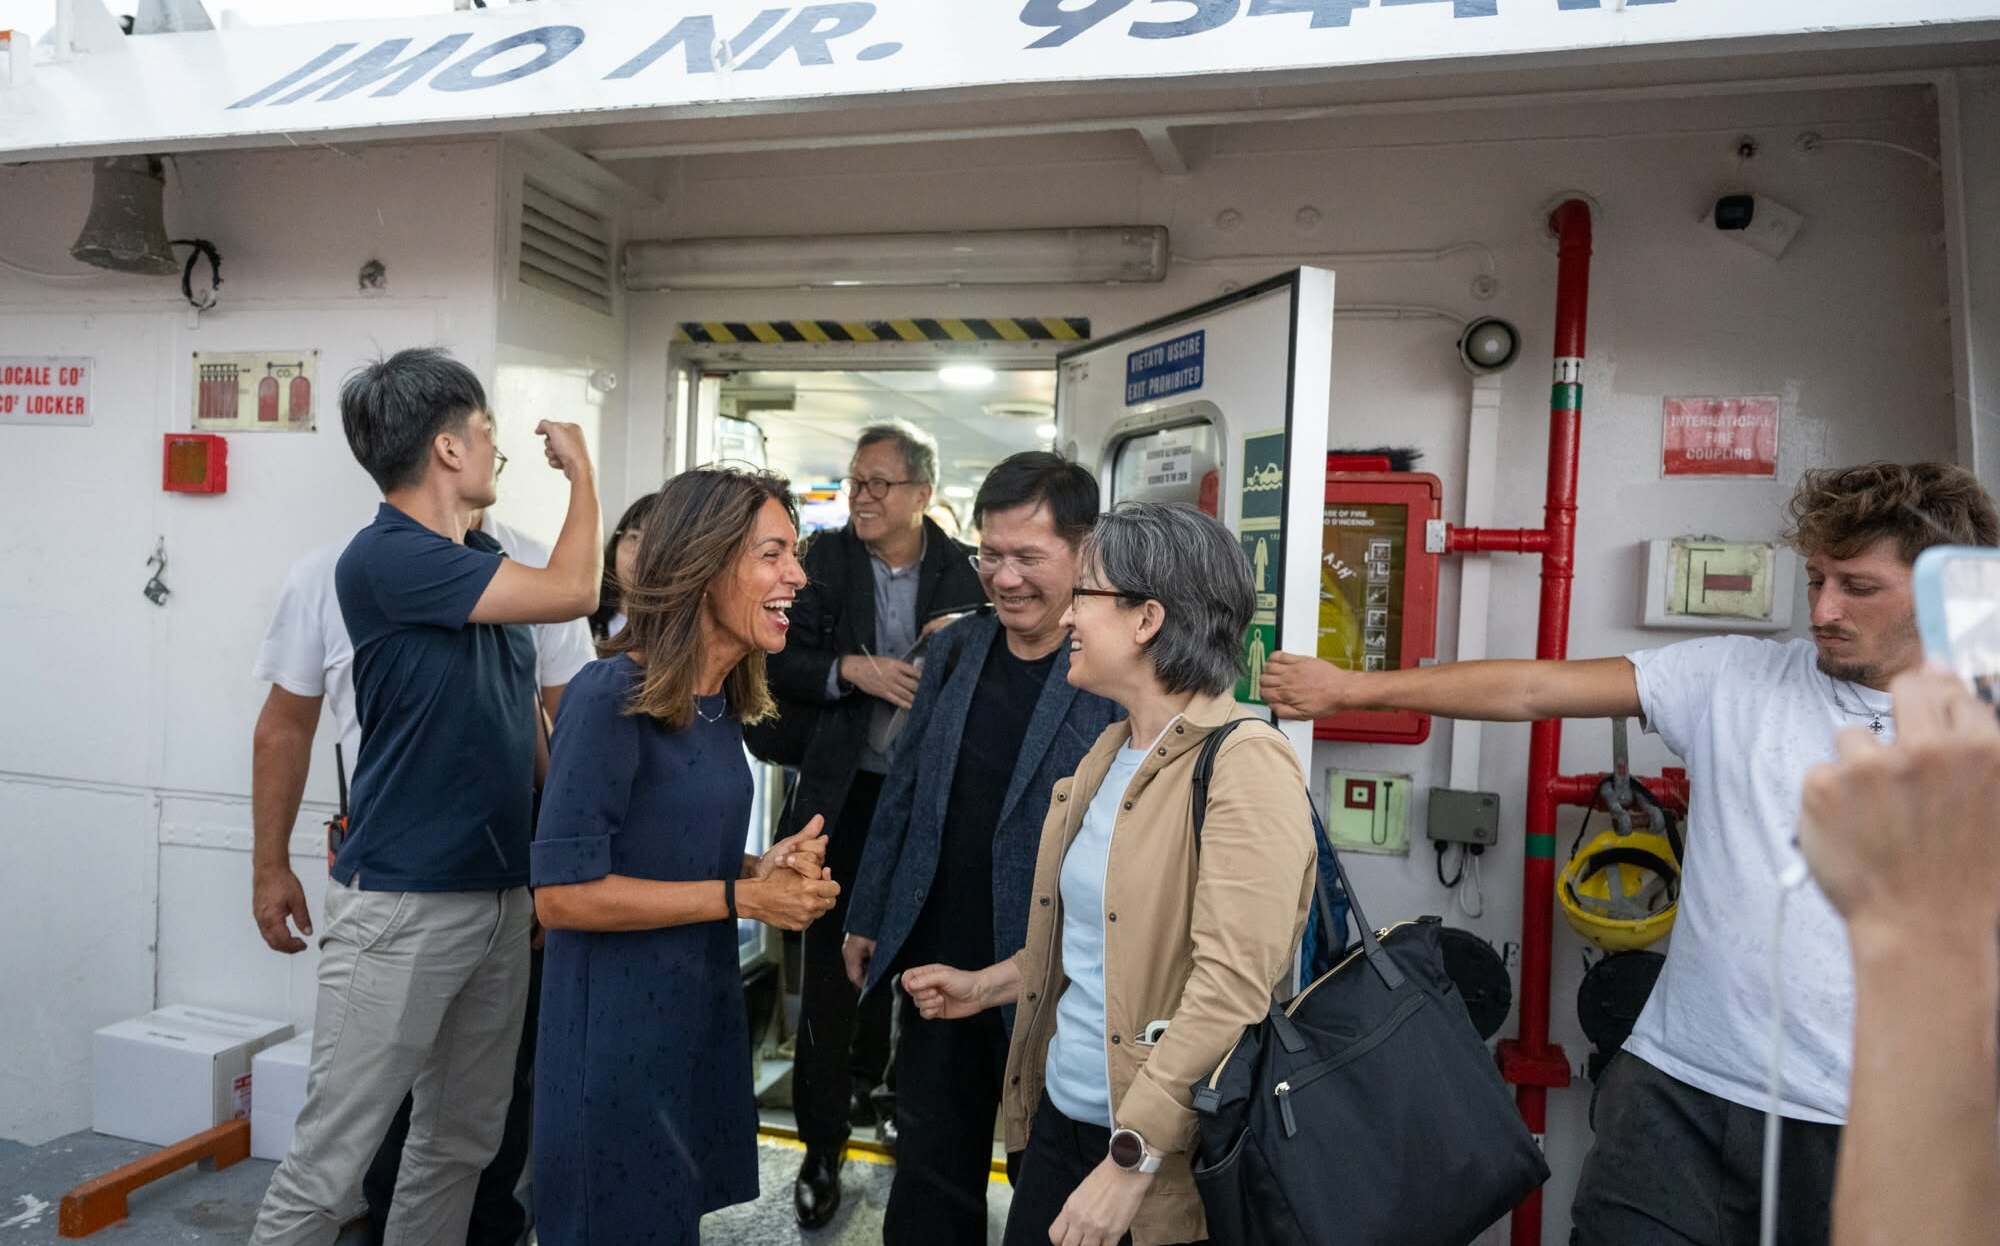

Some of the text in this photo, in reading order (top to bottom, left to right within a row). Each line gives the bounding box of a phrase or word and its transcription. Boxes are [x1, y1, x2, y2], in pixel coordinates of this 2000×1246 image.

[225, 25, 585, 109] IMO
[600, 2, 904, 80] NR.
[1130, 336, 1201, 374] VIETATO USCIRE
[1127, 366, 1201, 402] EXIT PROHIBITED
[26, 395, 85, 415] LOCKER
[1671, 415, 1769, 428] INTERNATIONAL
[1704, 431, 1736, 445] FIRE
[1686, 447, 1752, 461] COUPLING
[1338, 510, 1349, 518] OF
[1350, 510, 1367, 518] FIRE
